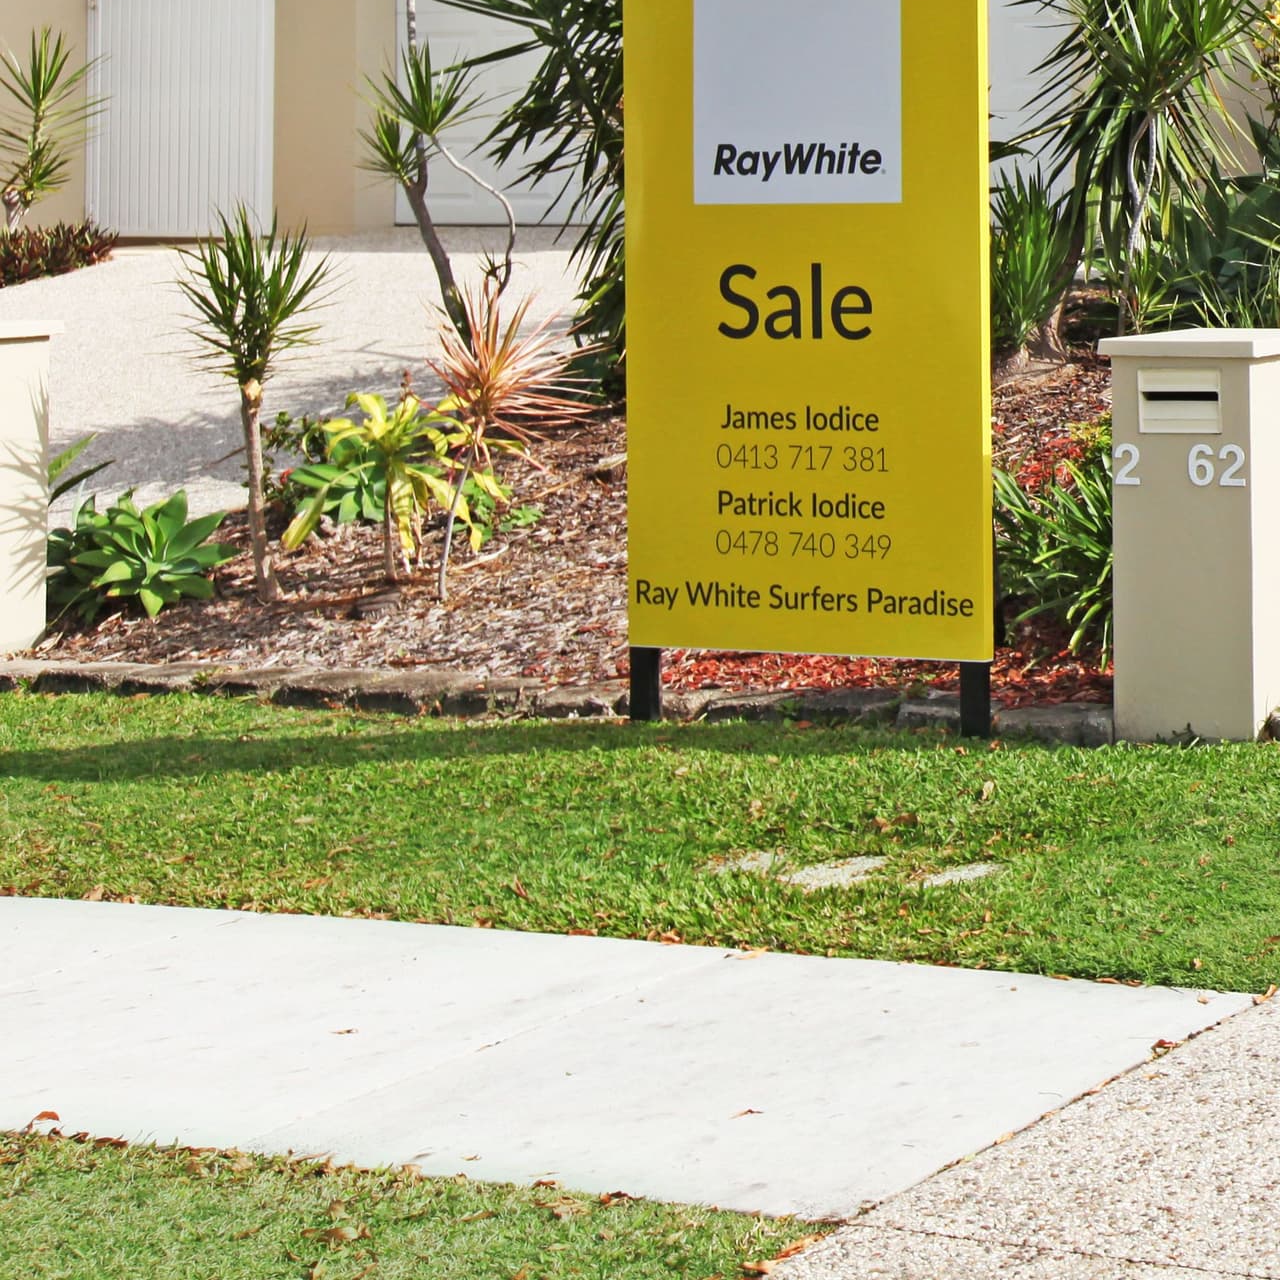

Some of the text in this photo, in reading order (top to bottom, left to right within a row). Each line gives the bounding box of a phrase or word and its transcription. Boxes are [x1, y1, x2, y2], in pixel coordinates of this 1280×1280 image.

[717, 262, 873, 341] Sale
[720, 403, 880, 432] James Iodice
[716, 443, 889, 473] 0413 717 381
[1114, 443, 1247, 487] 2 62
[718, 489, 886, 520] Patrick Iodice
[715, 529, 892, 560] 0478 740 349
[636, 578, 974, 618] Ray White Surfers Paradise
